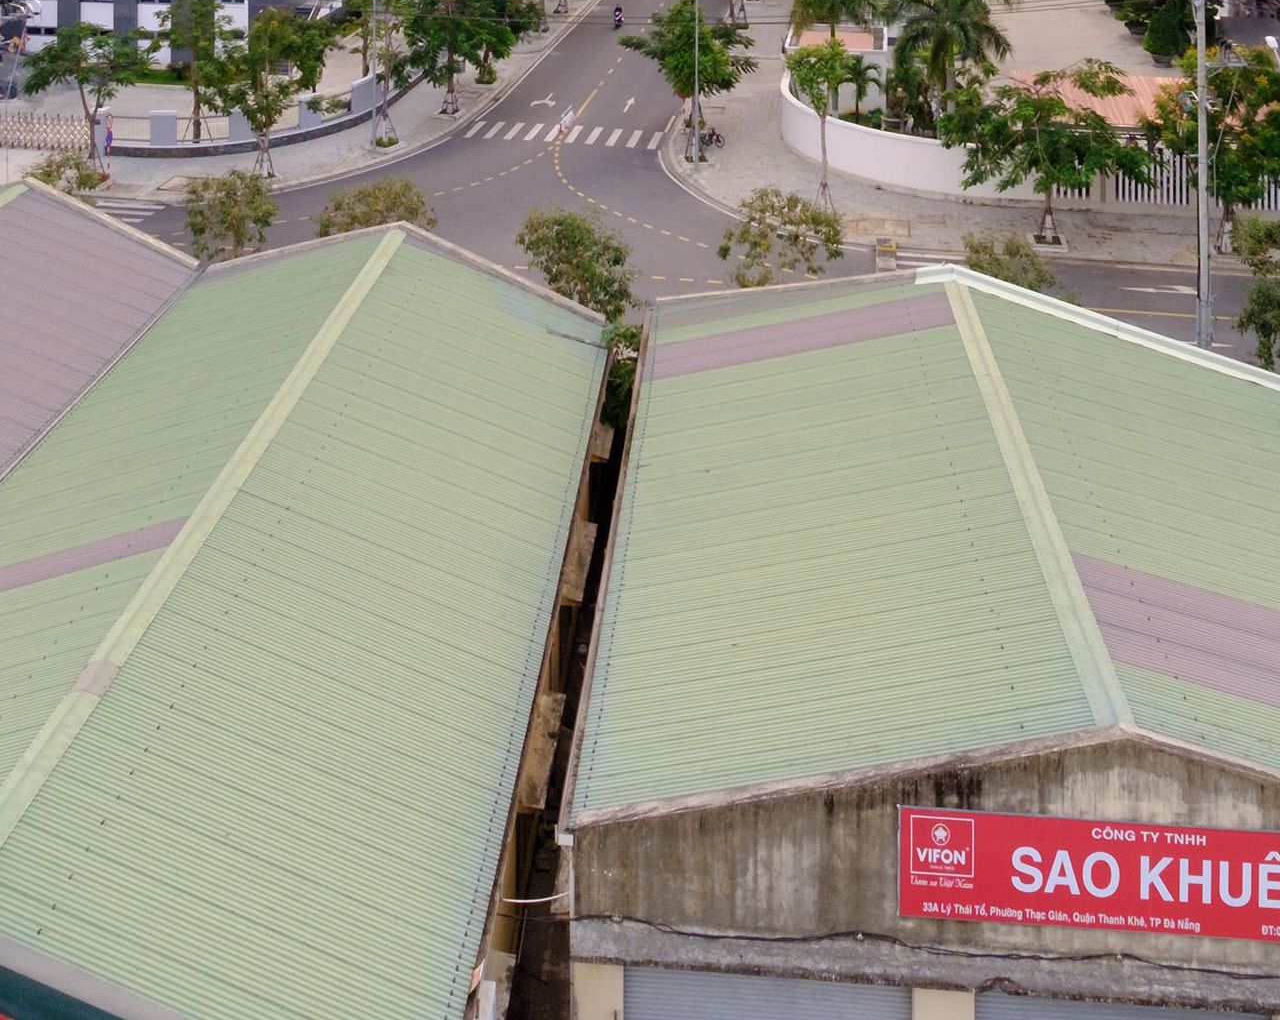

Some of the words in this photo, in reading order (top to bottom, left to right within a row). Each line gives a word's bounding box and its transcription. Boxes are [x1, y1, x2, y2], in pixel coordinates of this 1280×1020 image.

[1091, 826, 1136, 841] CÔNG
[1140, 831, 1160, 843] TY
[1164, 832, 1207, 846] TNHH
[916, 847, 966, 866] VIFON
[1011, 846, 1120, 898] SAO
[922, 902, 939, 913] 33A
[940, 903, 951, 915] Lý
[953, 903, 972, 915] Thái
[989, 906, 1023, 920] Phường
[1073, 912, 1096, 925] Quận
[1098, 913, 1125, 926] Thanh
[1149, 916, 1162, 928] TP
[1163, 917, 1176, 929] Đà
